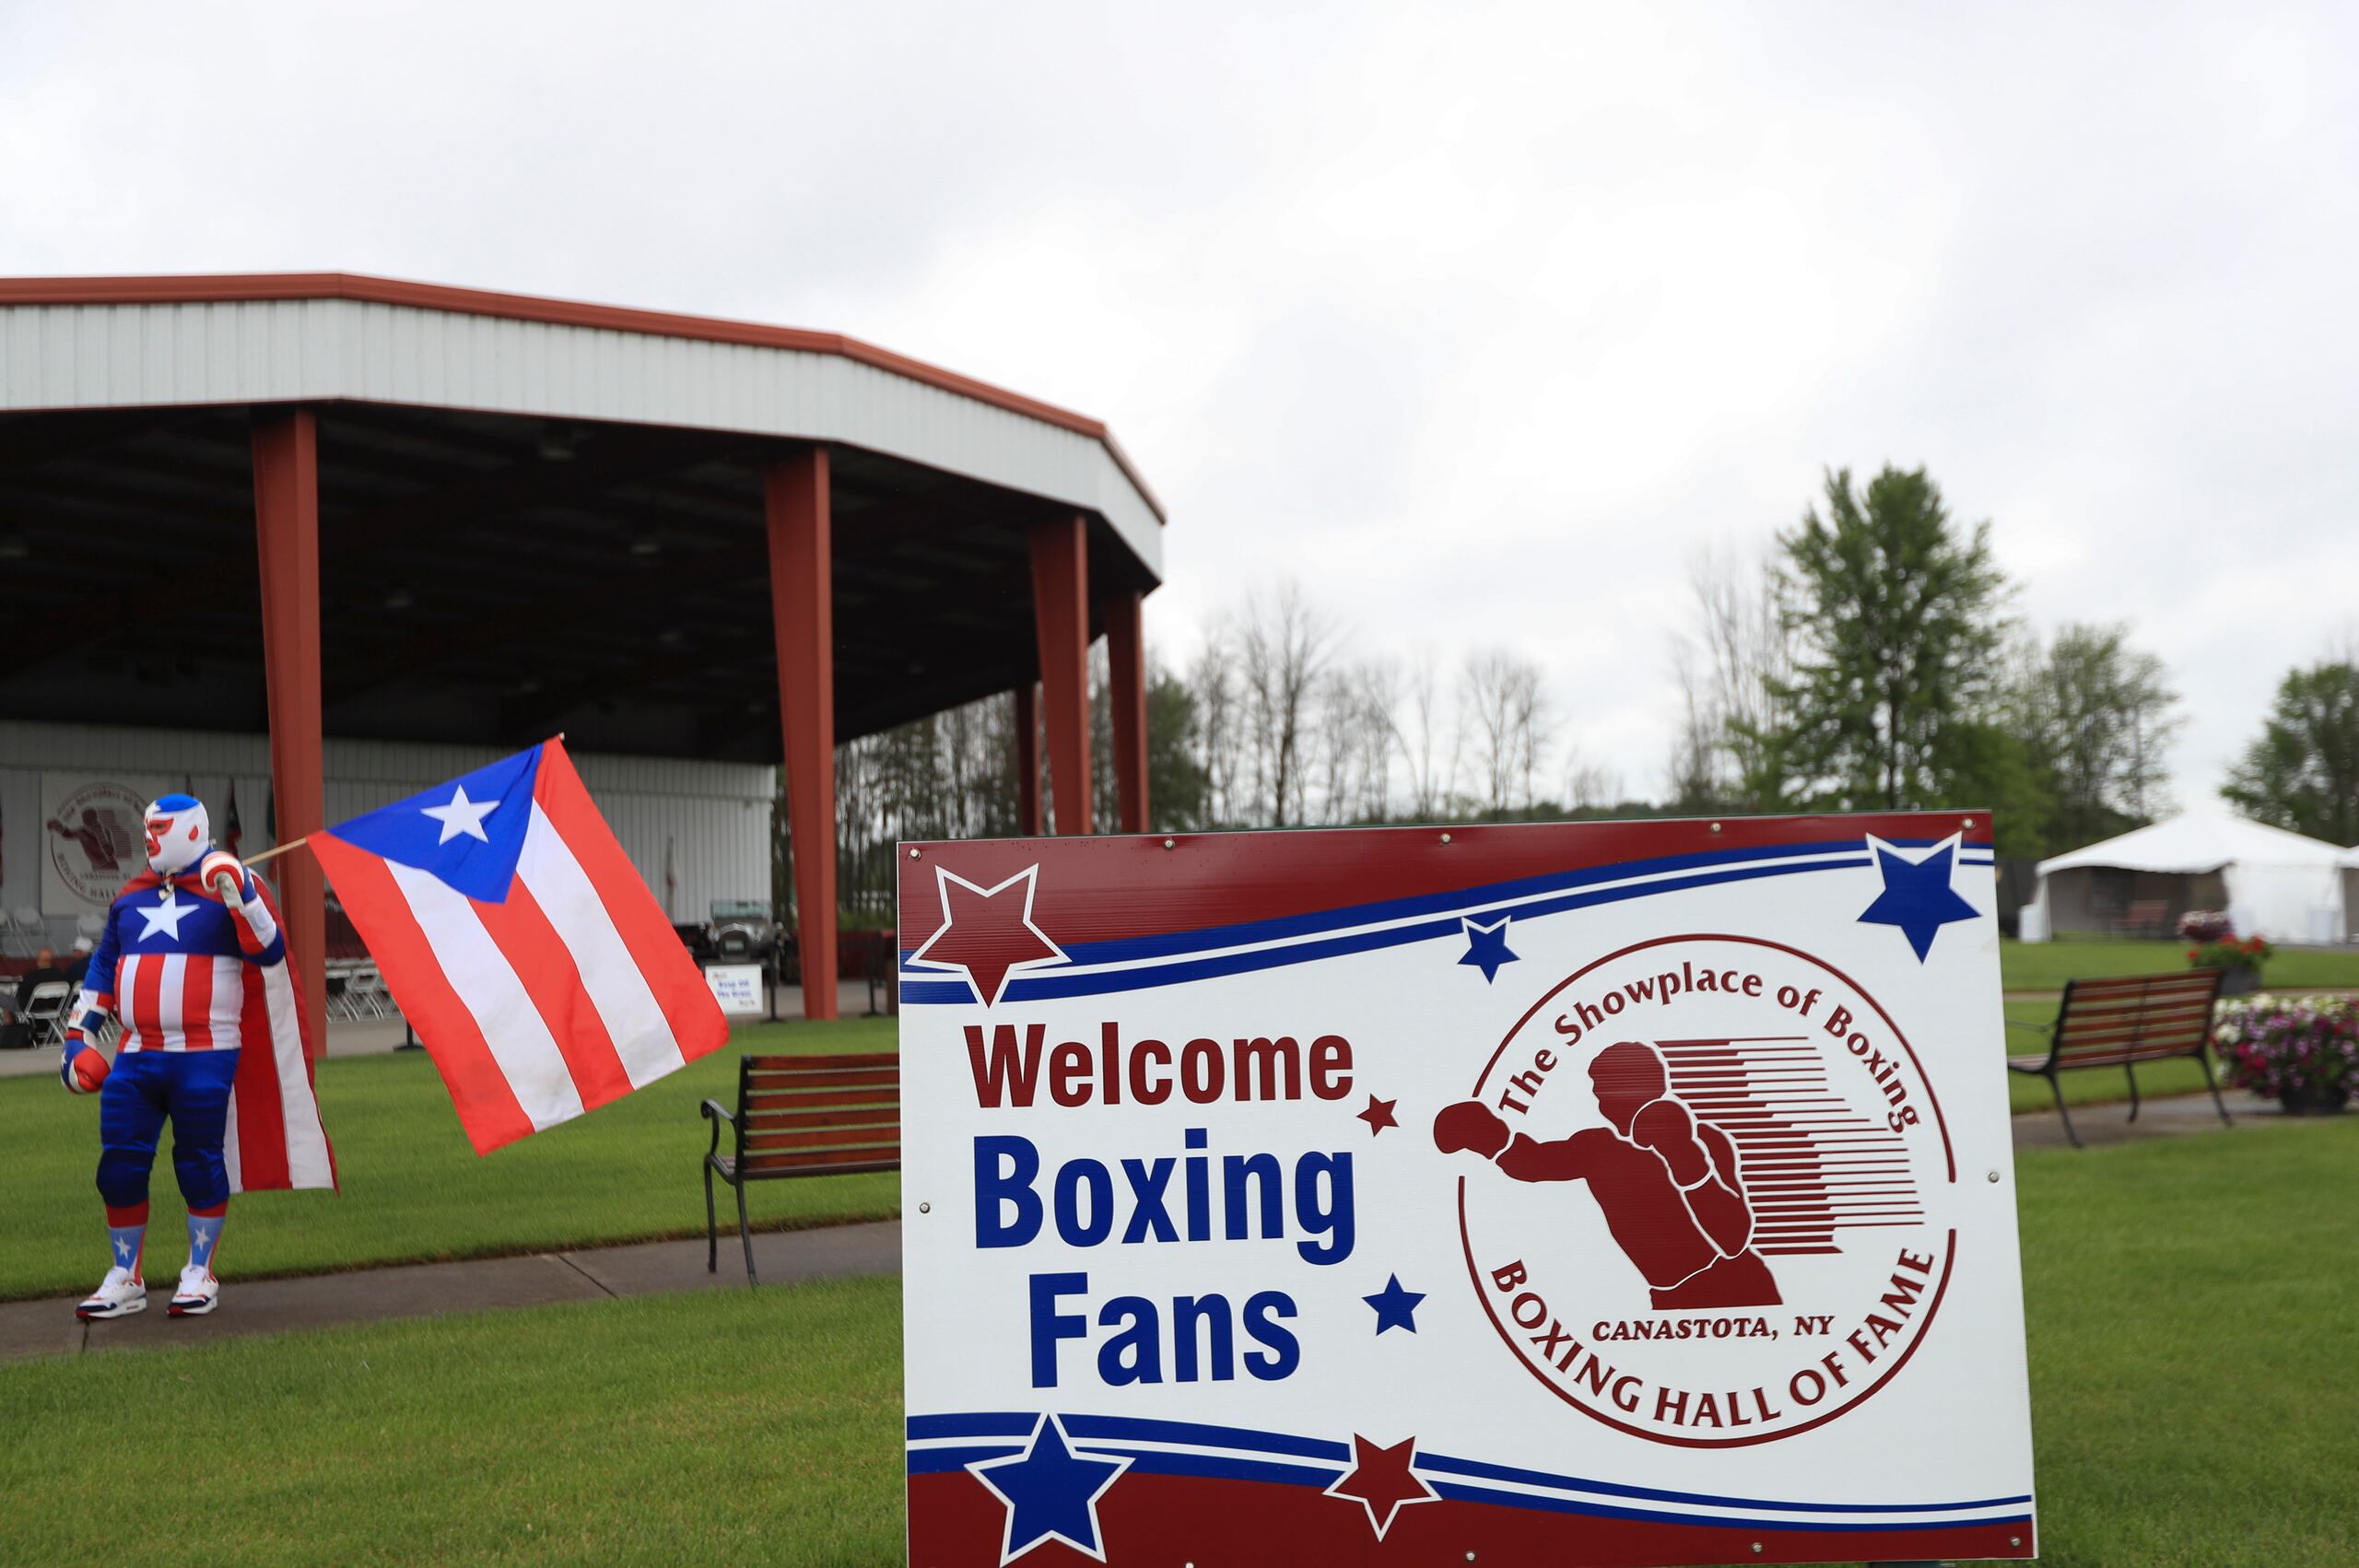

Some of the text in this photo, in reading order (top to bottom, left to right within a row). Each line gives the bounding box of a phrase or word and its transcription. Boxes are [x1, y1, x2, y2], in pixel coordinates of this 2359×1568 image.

[963, 1021, 1354, 1108] Welcome
[1497, 961, 1921, 1133] The Showplace of Boxing
[973, 1128, 1356, 1266] Boxing
[1028, 1271, 1301, 1388] Fans
[1490, 1246, 1935, 1428] BOXING HALL OF FAME
[1591, 1316, 1836, 1342] CANASTOTA, NY
